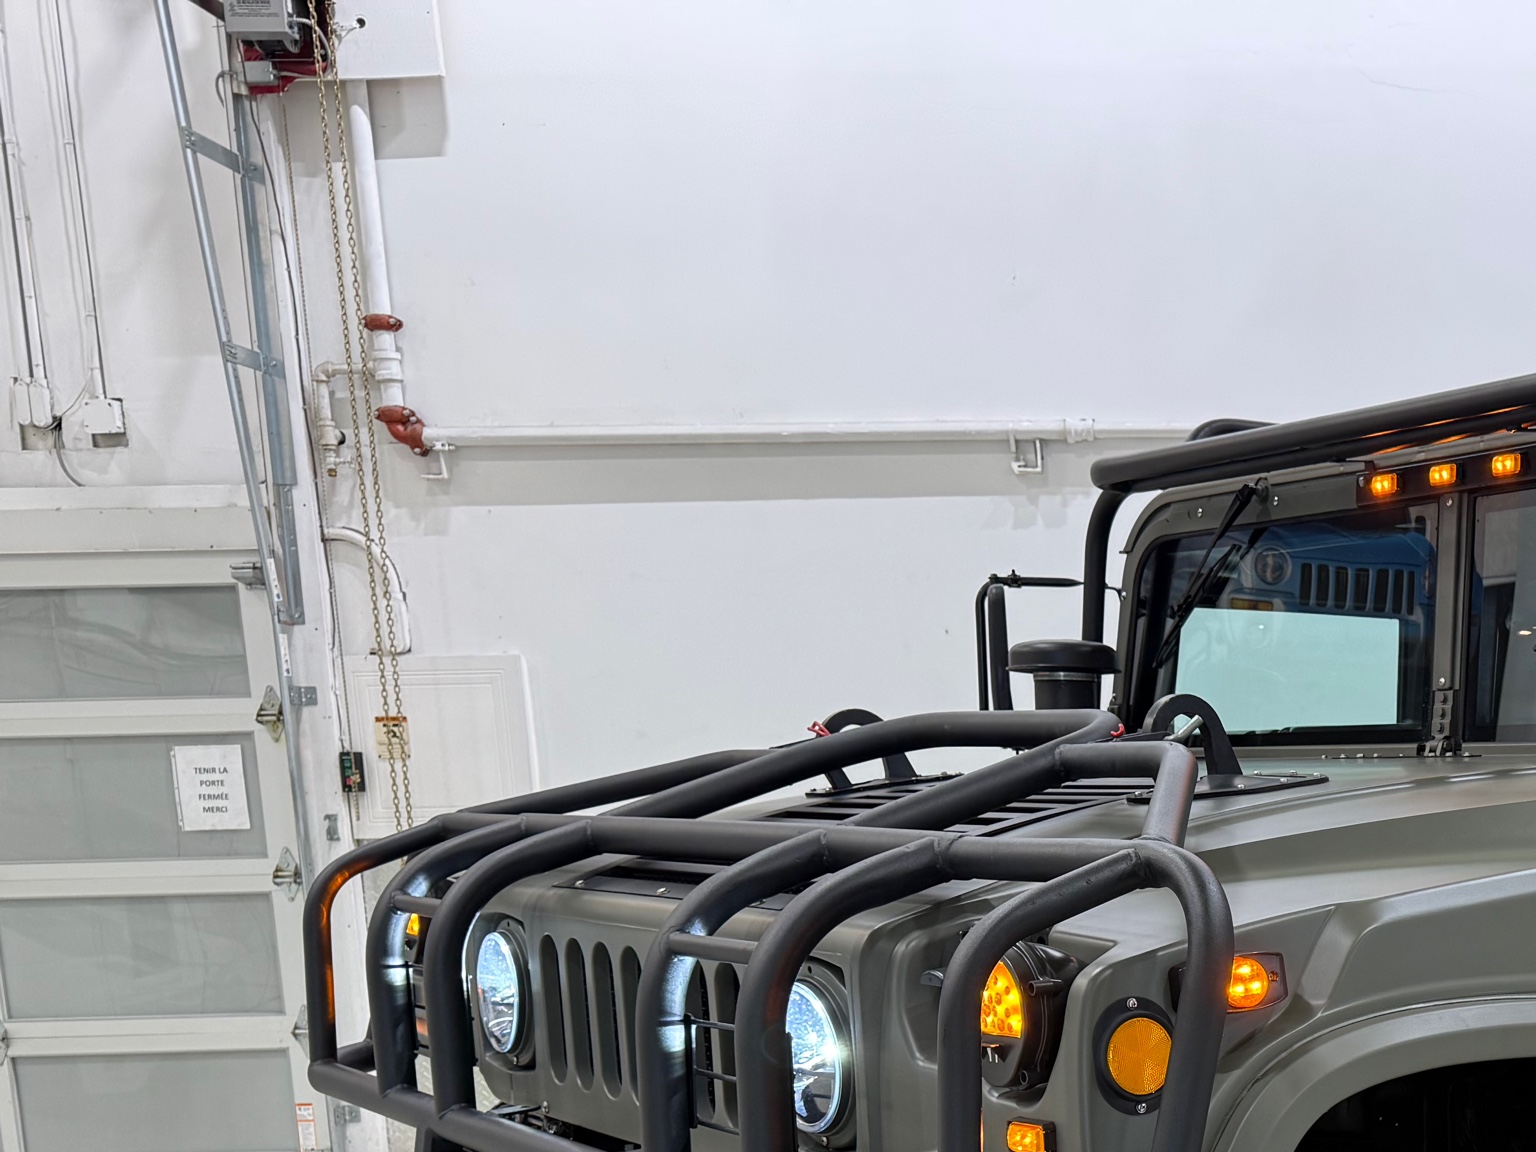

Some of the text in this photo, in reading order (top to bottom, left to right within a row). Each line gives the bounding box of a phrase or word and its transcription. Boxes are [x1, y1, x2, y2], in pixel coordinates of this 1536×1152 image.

[193, 766, 229, 775] TENIR LA
[199, 780, 225, 788] PORTE
[198, 792, 229, 801] FERMÉE
[202, 806, 228, 814] MERCI
